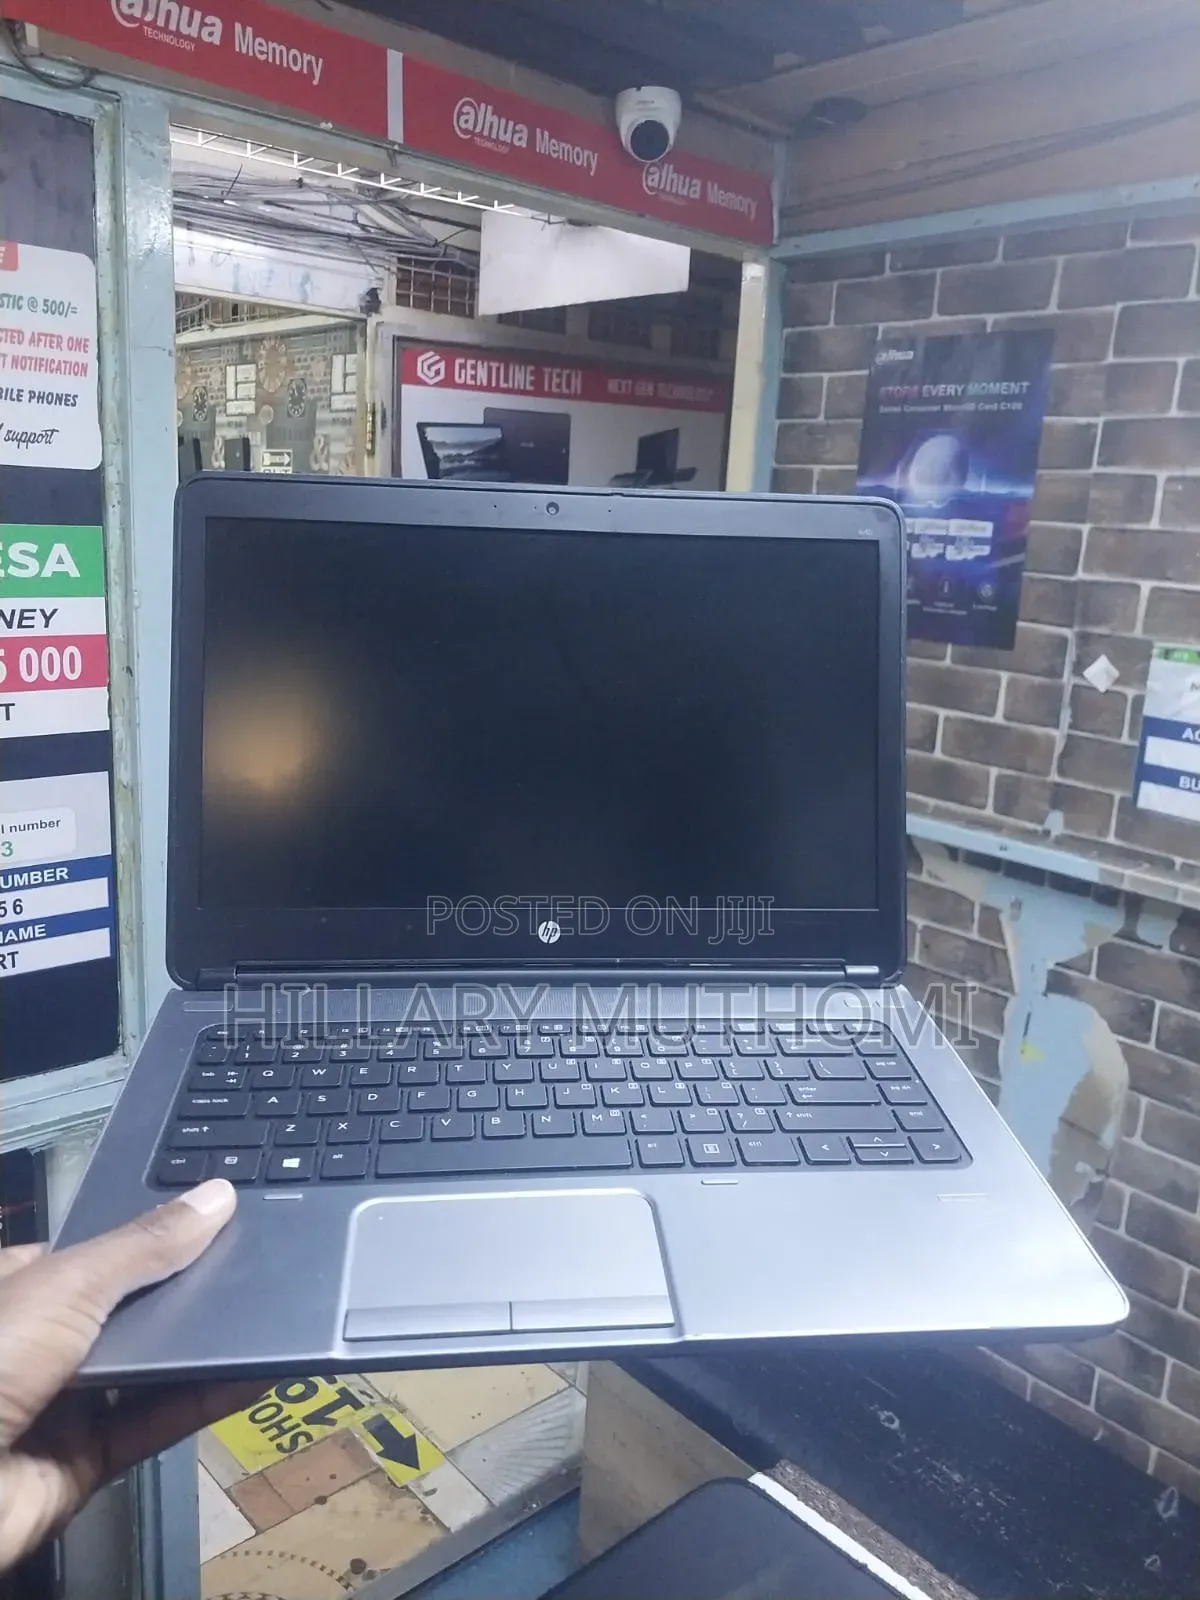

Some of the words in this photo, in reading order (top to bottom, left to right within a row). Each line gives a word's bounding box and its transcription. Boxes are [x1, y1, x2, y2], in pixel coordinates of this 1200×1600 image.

[143, 26, 196, 51] TECHNOLOGY
[234, 21, 323, 85] Memory
[535, 128, 598, 176] Memory
[707, 181, 757, 221] Memory
[27, 297, 38, 313] @
[42, 298, 78, 318] 500/=
[29, 332, 63, 351] AFTER
[67, 336, 90, 353] ONE
[10, 355, 89, 378] NOTIFICATION
[454, 358, 535, 390] GENTLINE
[543, 368, 582, 396] TECH
[28, 390, 78, 407] PHONES
[922, 384, 965, 398] EVERY
[967, 382, 1029, 396] MOMENT
[4, 429, 59, 449] support
[0, 541, 80, 578] SA
[10, 820, 61, 834] number
[1, 840, 14, 857] 3
[538, 921, 561, 943] hp
[454, 1064, 464, 1072] T
[267, 1096, 279, 1104] A
[467, 1090, 477, 1098] G
[338, 1122, 349, 1130] X
[390, 1120, 401, 1128] C
[440, 1118, 452, 1126] V
[492, 1117, 501, 1125] B
[592, 1114, 603, 1122] M
[286, 1124, 297, 1132] Z
[249, 1393, 313, 1454] SHO
